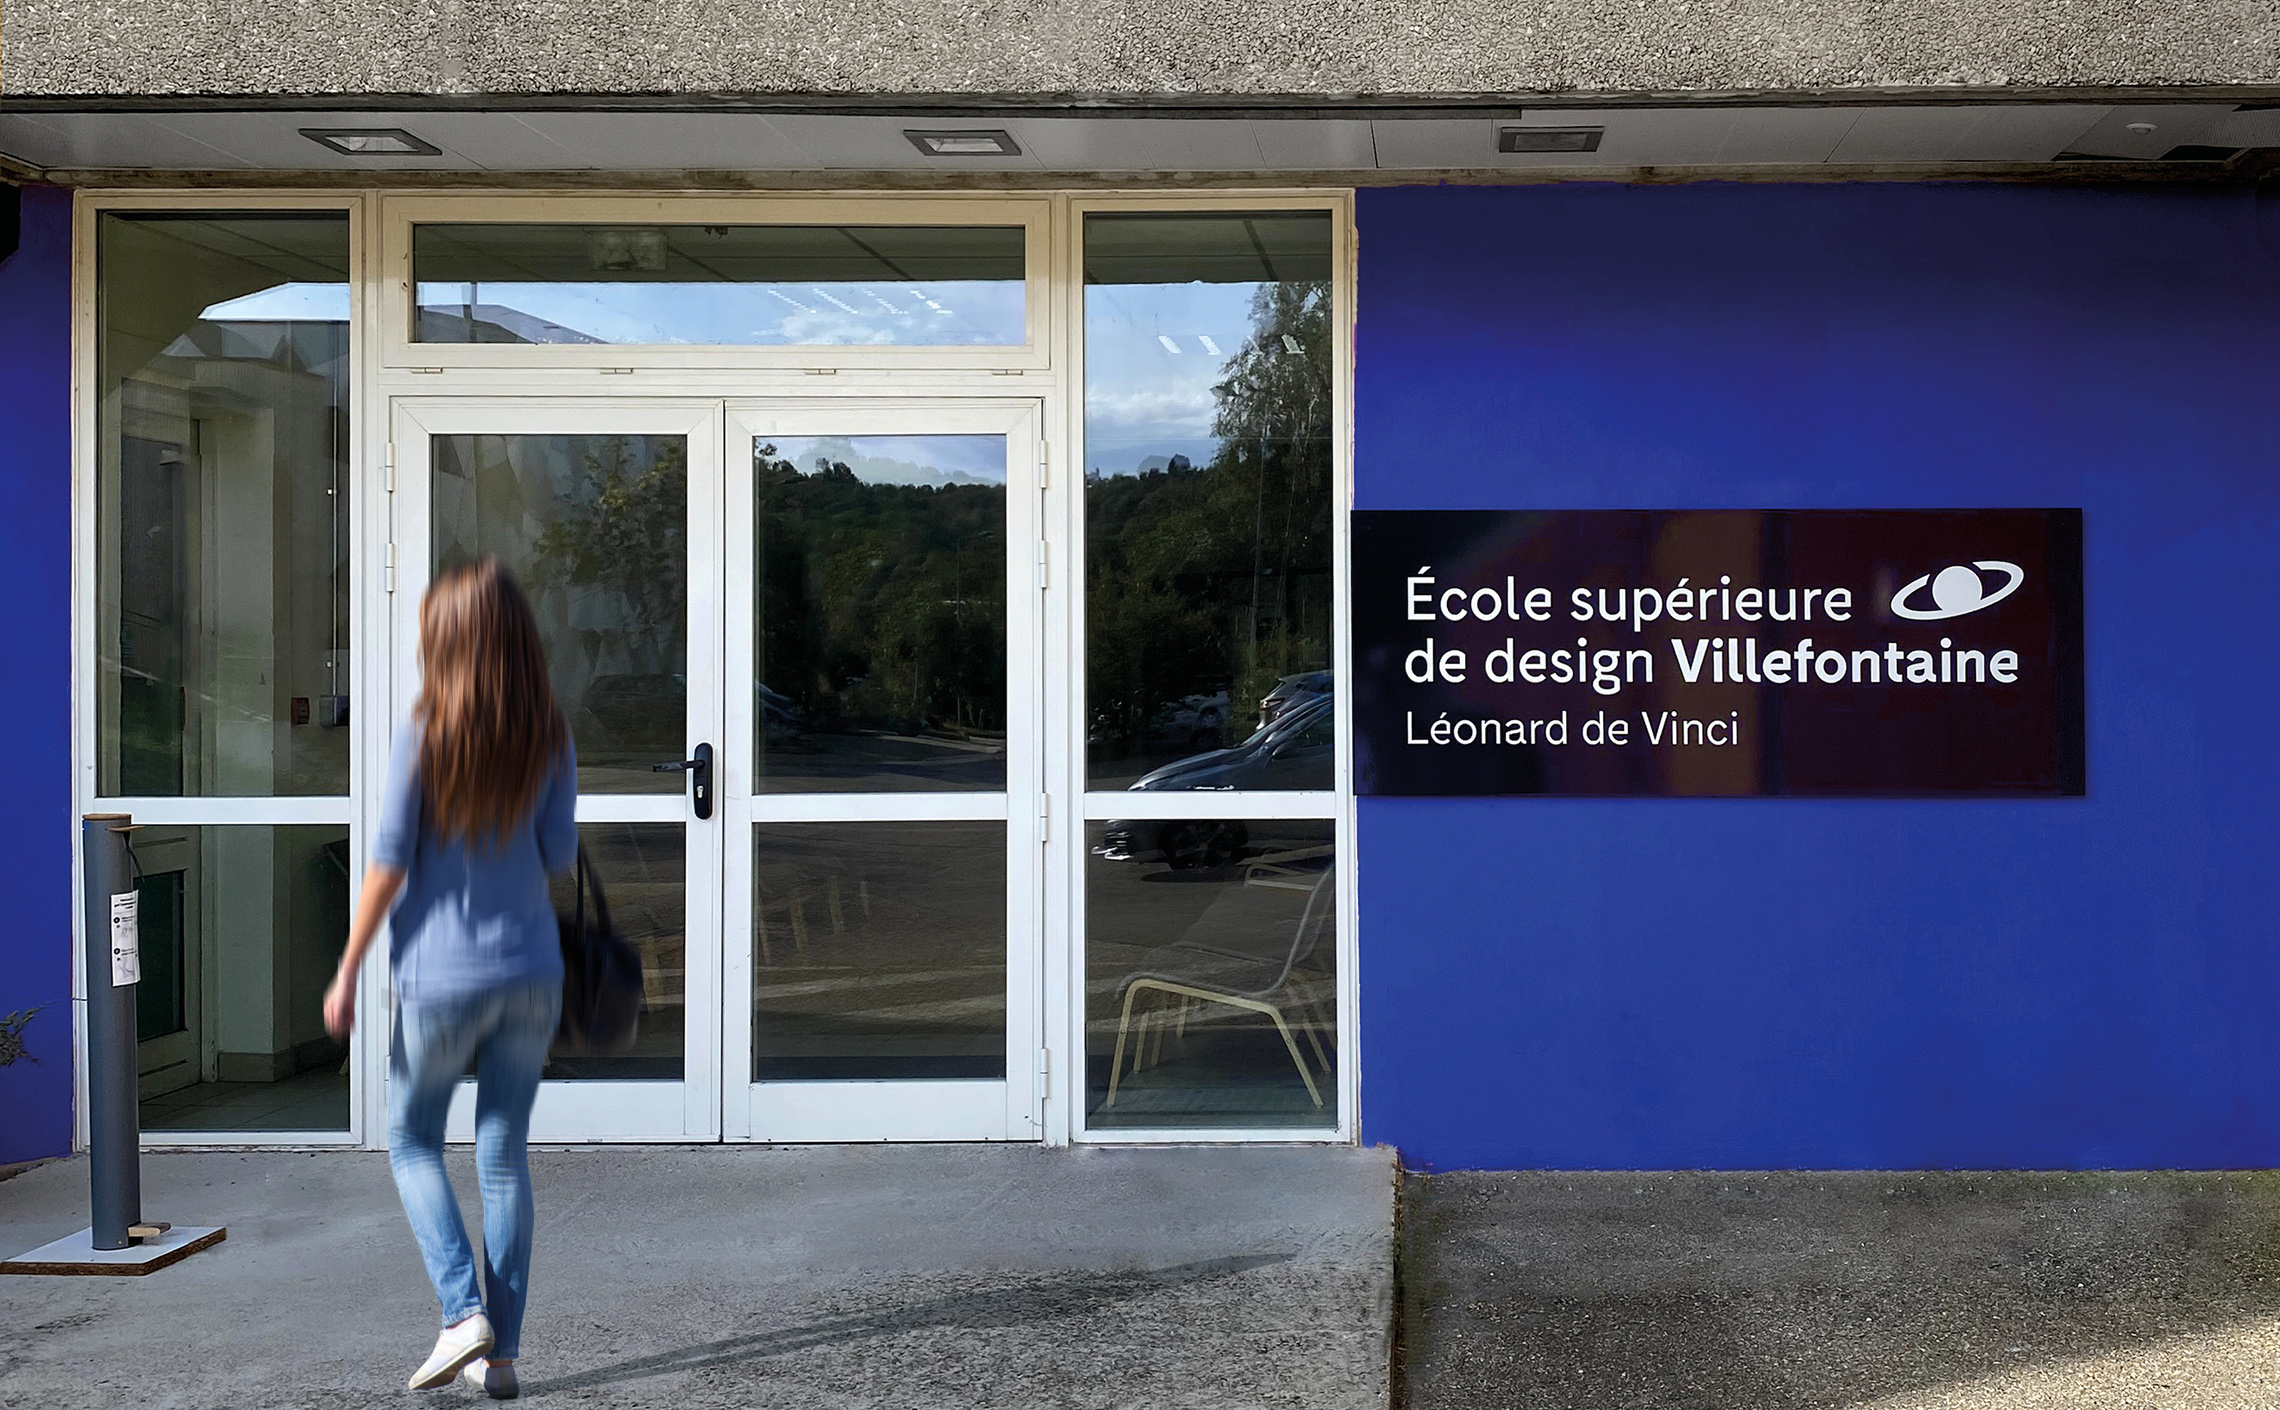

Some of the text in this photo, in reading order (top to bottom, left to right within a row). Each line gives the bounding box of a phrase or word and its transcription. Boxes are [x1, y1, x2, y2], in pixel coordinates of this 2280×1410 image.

[1407, 565, 1853, 632] École supérieure
[1404, 637, 2020, 696] de design Villefontaine
[1407, 710, 1739, 746] Léonard de Vinci
